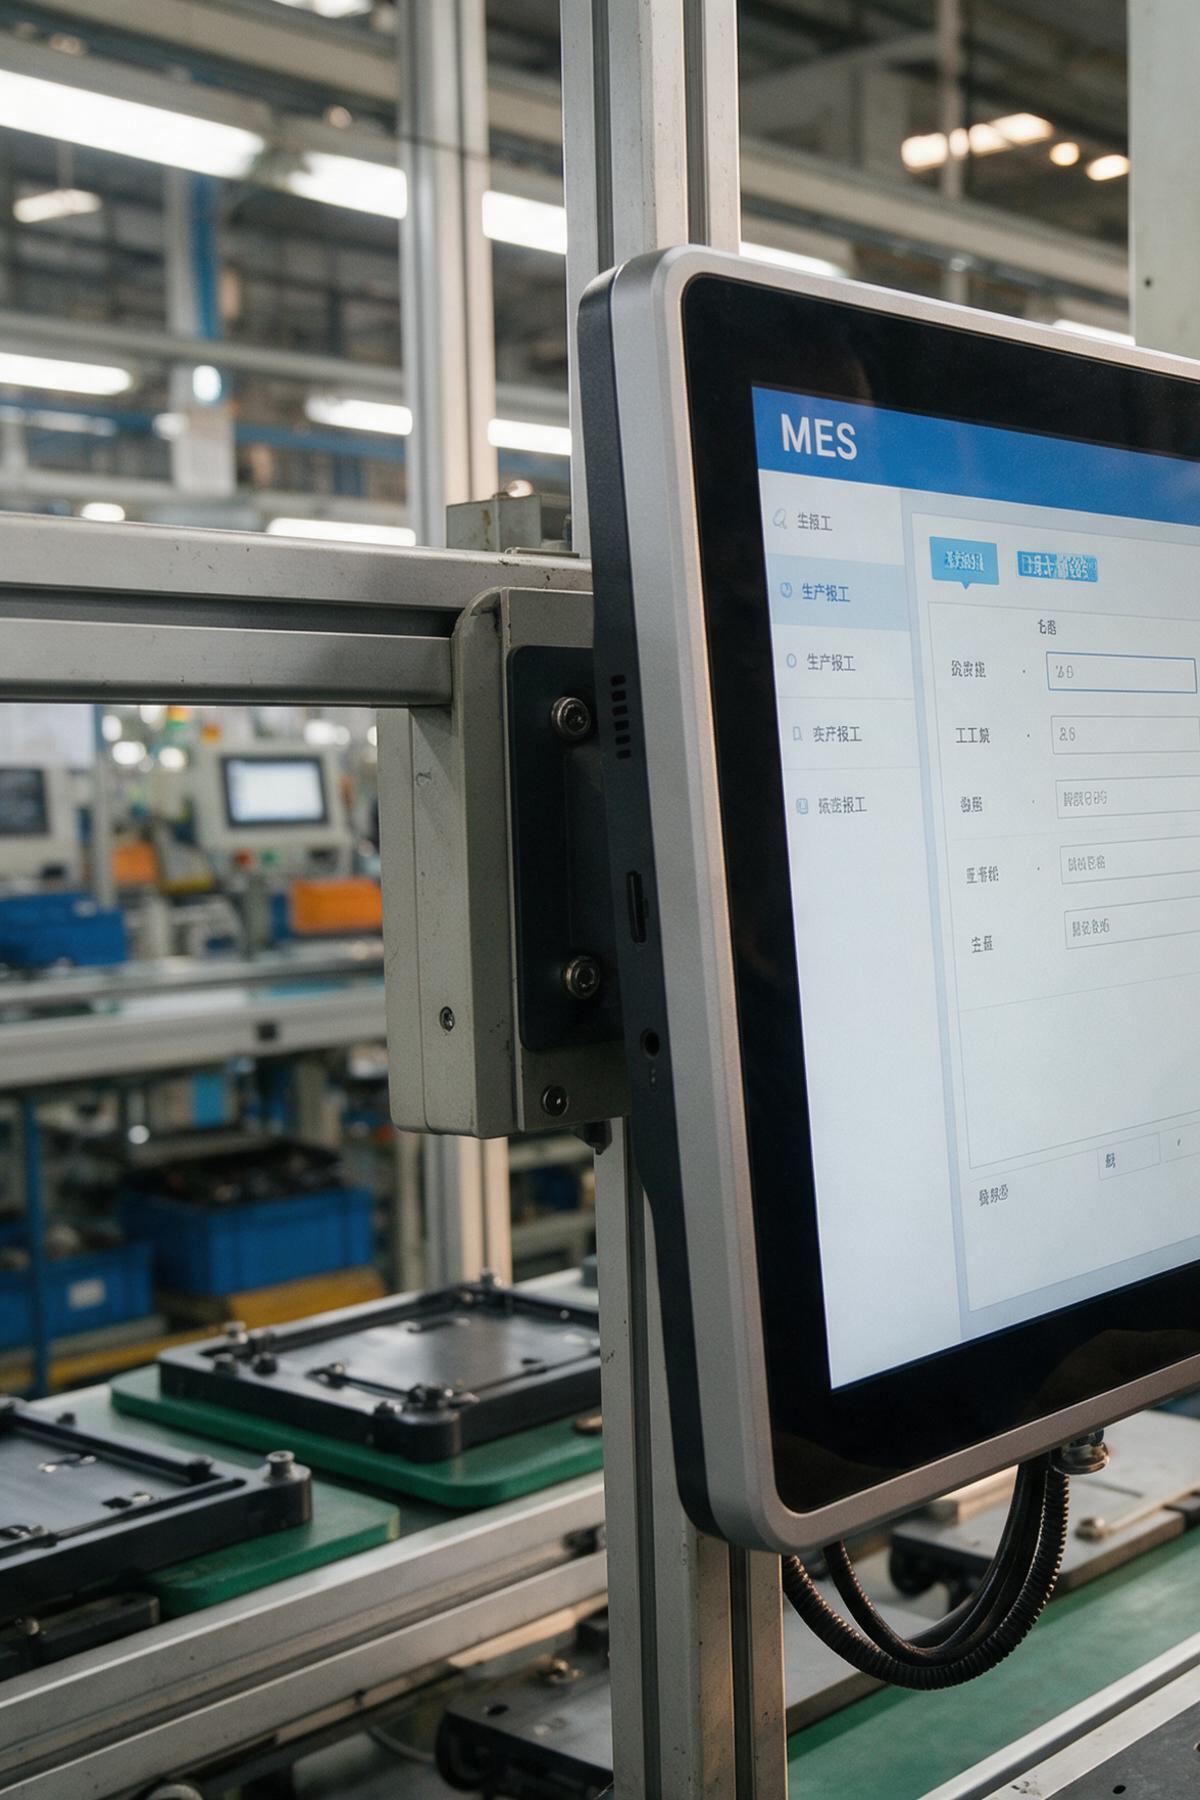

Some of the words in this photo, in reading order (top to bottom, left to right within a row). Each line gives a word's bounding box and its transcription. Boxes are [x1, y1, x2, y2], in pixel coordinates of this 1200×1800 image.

[780, 413, 858, 460] MES
[802, 583, 851, 603] 生产报工
[807, 653, 856, 672] 生产报工
